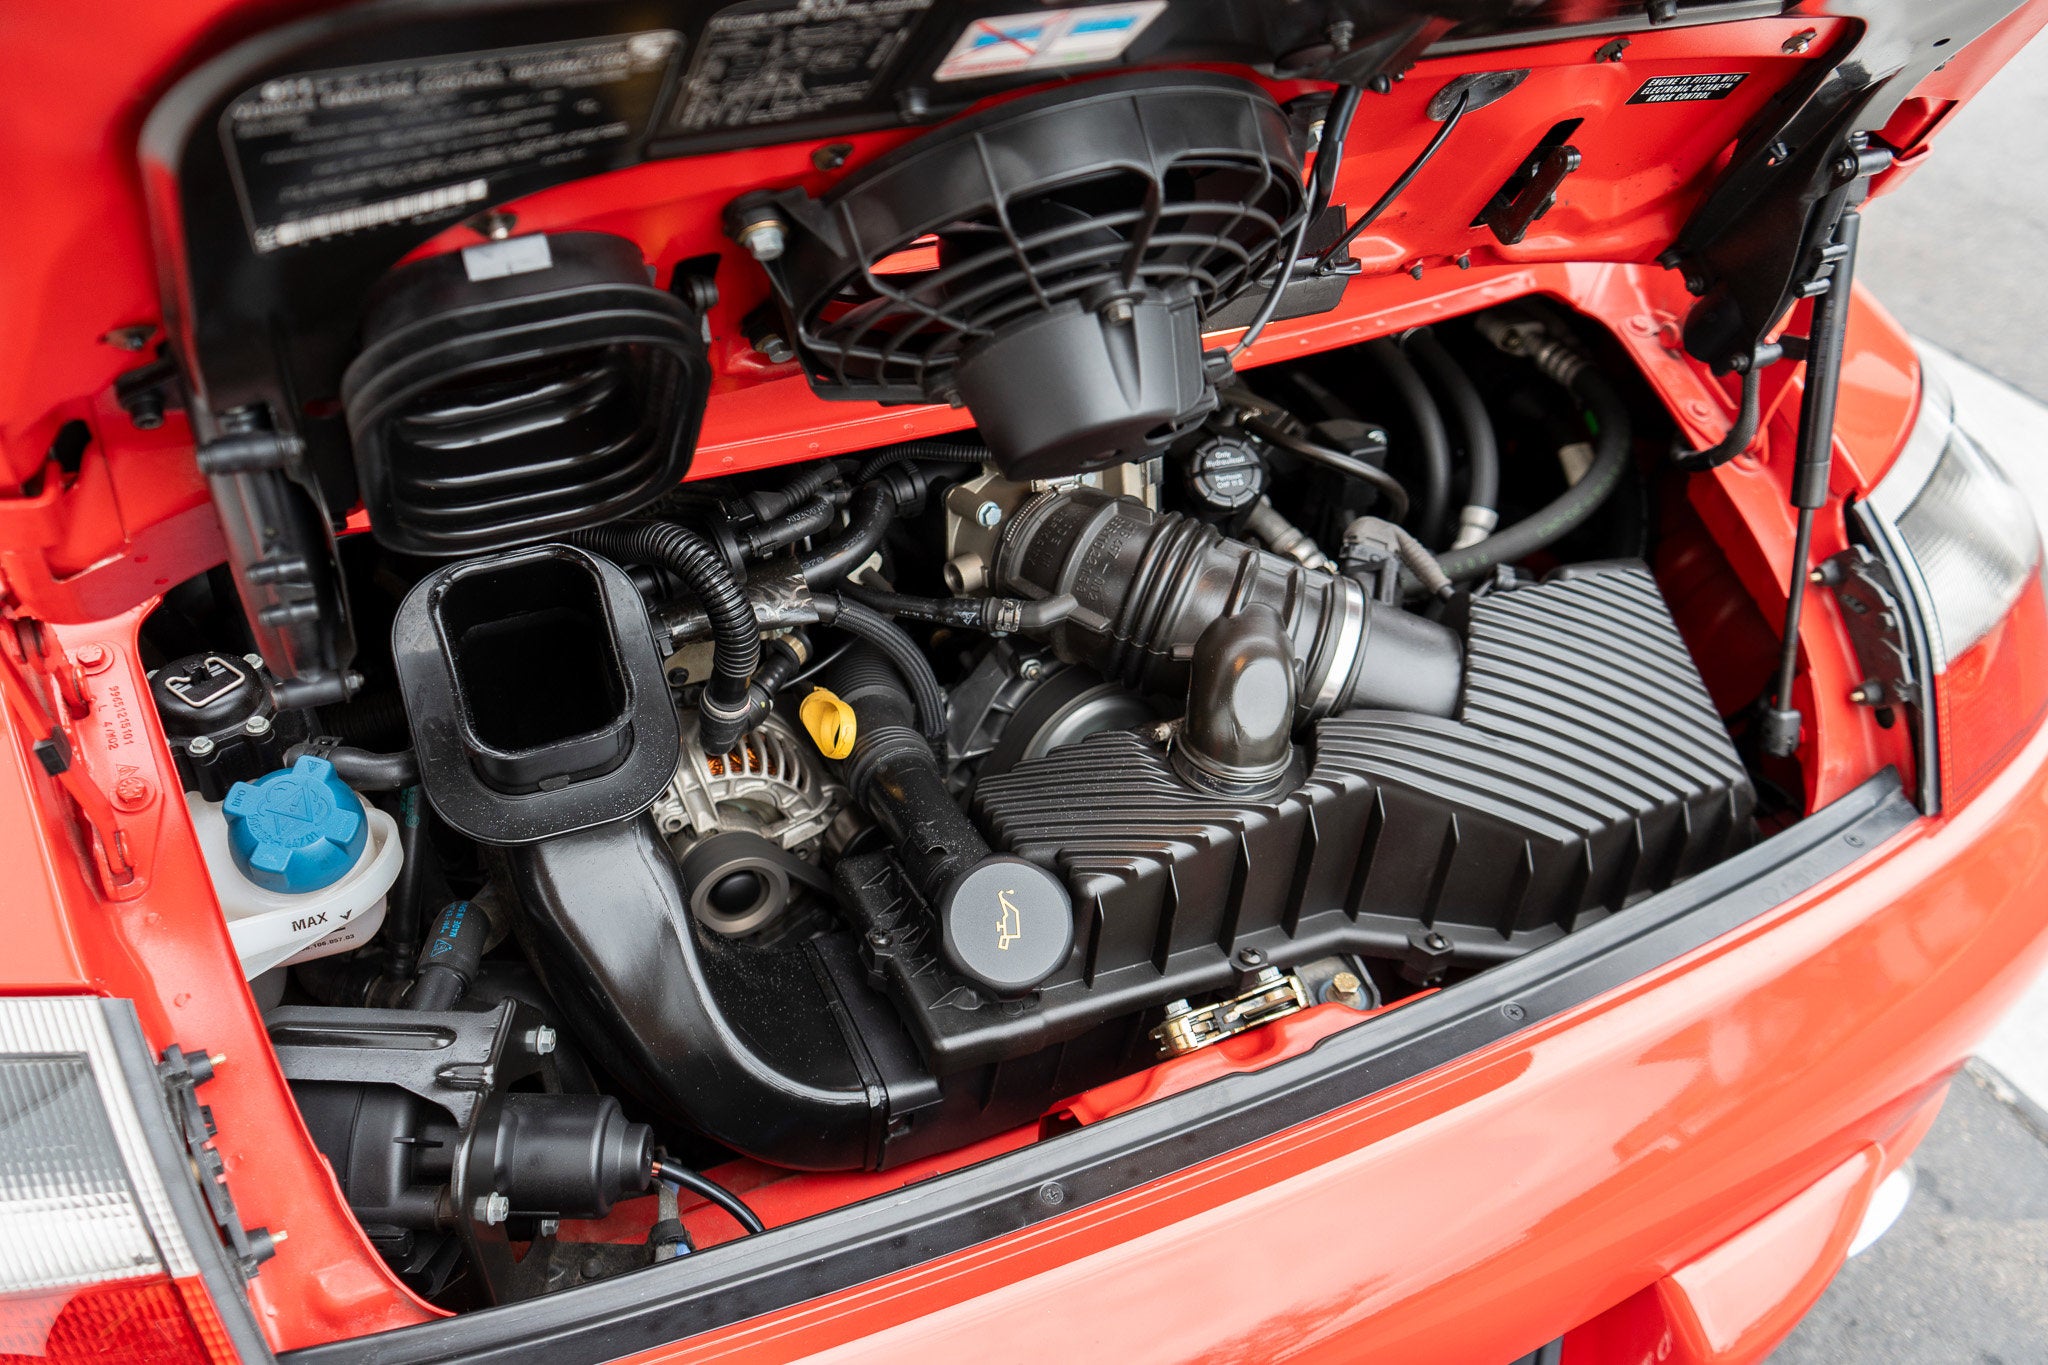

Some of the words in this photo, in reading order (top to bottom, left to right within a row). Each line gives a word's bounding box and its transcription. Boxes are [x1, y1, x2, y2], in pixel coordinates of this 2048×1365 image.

[1648, 77, 1679, 86] ENGINE
[1679, 76, 1691, 84] IS
[1691, 75, 1719, 84] FITTED
[1720, 74, 1744, 82] WITH
[1640, 84, 1691, 95] ELECTRONIC
[1645, 93, 1675, 102] KNOCK
[1674, 92, 1712, 100] CONTROL
[109, 685, 135, 745] 99651215101
[291, 911, 328, 932] MAX
[449, 919, 461, 938] MADE
